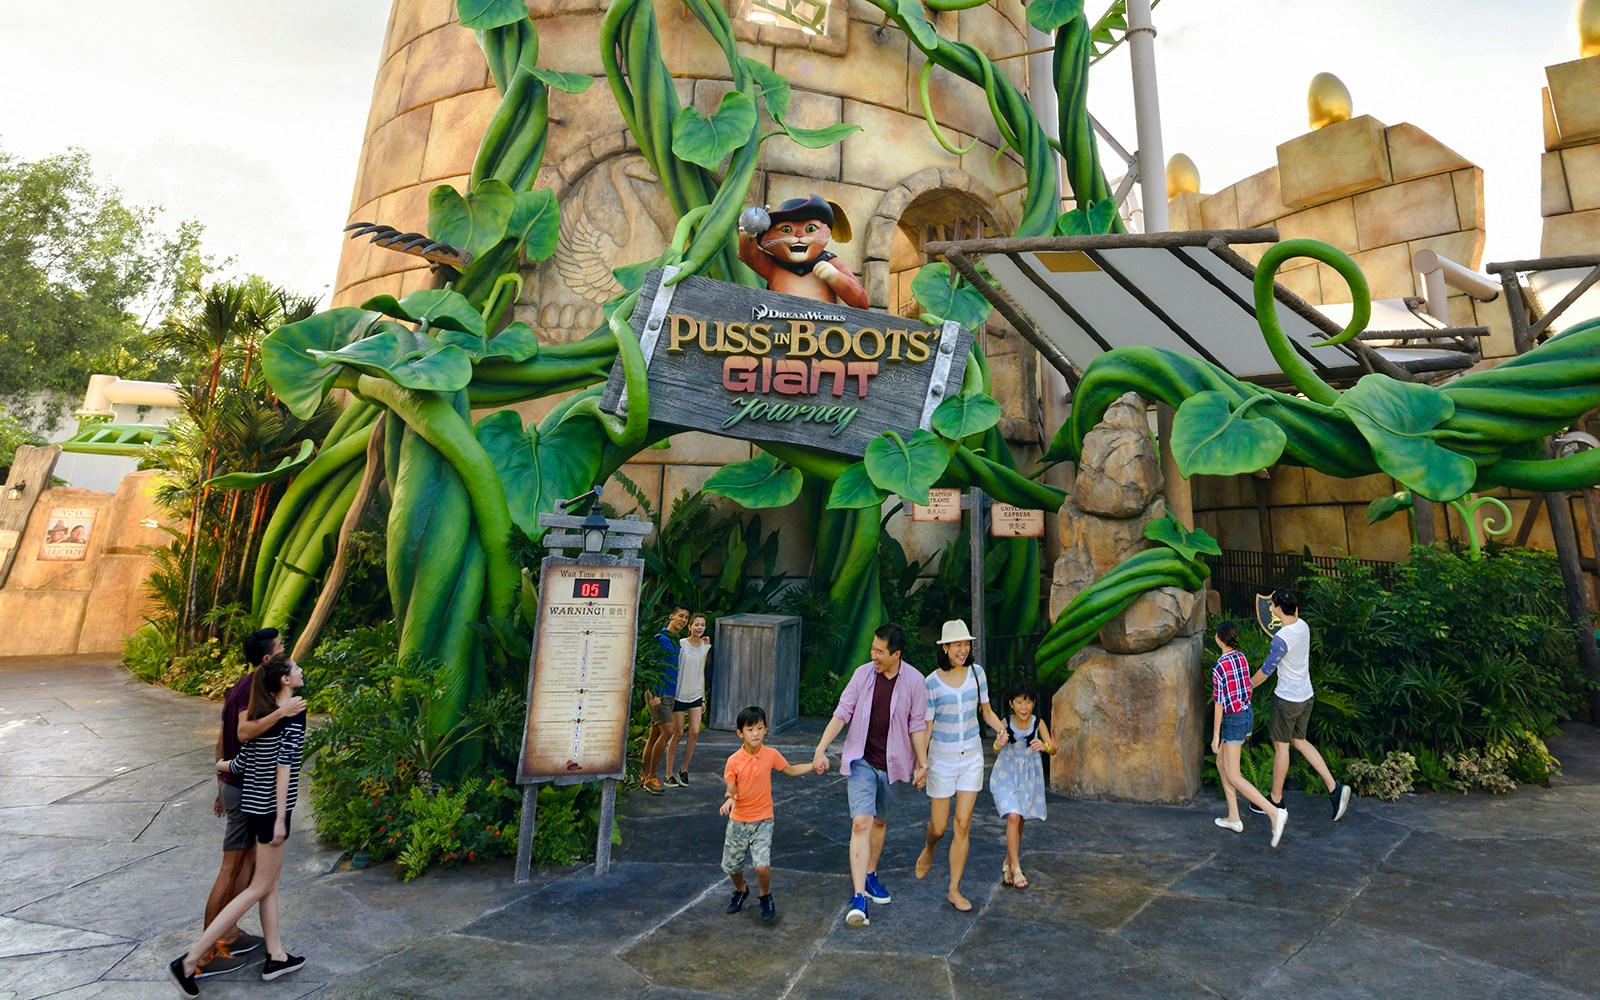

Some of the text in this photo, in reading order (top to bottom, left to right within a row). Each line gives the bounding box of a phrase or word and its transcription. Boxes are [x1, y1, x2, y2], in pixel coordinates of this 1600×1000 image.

[767, 309, 847, 321] DREAMWORKS
[667, 314, 773, 355] PUSS
[774, 332, 791, 345] IN
[722, 355, 880, 398] GIANT
[721, 397, 861, 437] Journey
[560, 570, 577, 578] Wait
[578, 570, 596, 578] Time
[581, 583, 600, 597] 05
[549, 606, 605, 616] WARNING!
